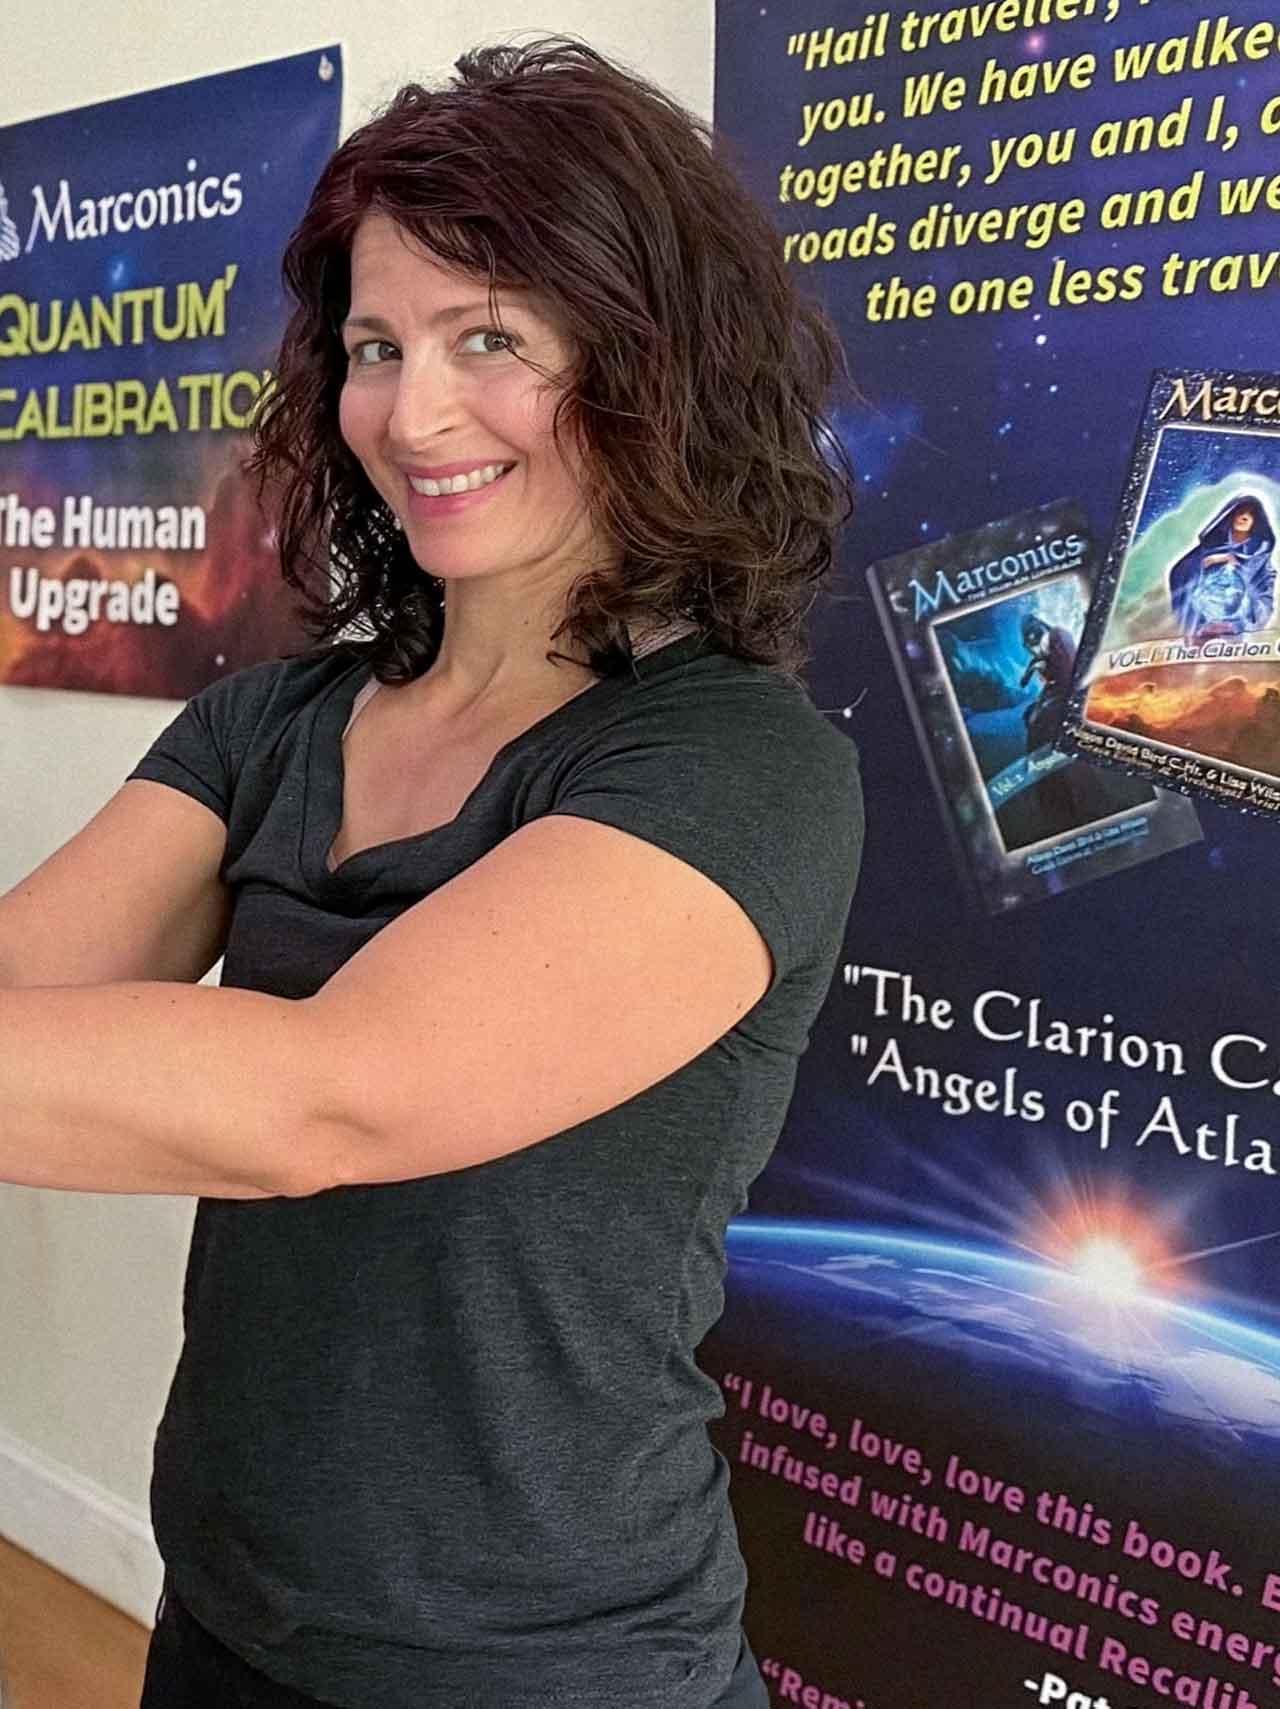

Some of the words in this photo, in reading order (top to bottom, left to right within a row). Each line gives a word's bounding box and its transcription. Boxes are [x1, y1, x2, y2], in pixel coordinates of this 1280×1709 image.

[787, 13, 890, 71] "Hail
[901, 0, 1120, 55] traveller,
[798, 92, 886, 146] you.
[903, 74, 965, 118] We
[979, 53, 1096, 105] have
[1114, 16, 1280, 83] walke
[779, 144, 973, 208] together,
[985, 128, 1076, 184] you
[1090, 97, 1193, 159] and
[25, 158, 243, 254] Marconics
[784, 213, 896, 264] roads
[909, 199, 1085, 249] diverge
[1101, 171, 1205, 229] and
[866, 277, 934, 321] the
[949, 273, 1033, 316] one
[1048, 260, 1145, 307] less
[1162, 252, 1280, 297] trav
[1158, 379, 1280, 420] Marc
[62, 496, 207, 549] Human
[10, 566, 180, 636] Upgrade
[908, 534, 1087, 624] Marconics
[844, 963, 955, 1031] "The
[972, 989, 1186, 1076] Clarion
[1211, 1033, 1280, 1097] C
[850, 1034, 1045, 1122] "Angels
[1065, 1090, 1120, 1150] of
[1135, 1096, 1278, 1175] Atla
[760, 1386, 837, 1449] love,
[848, 1419, 933, 1486] love,
[944, 1455, 1025, 1512] love
[1036, 1490, 1112, 1545] this
[1122, 1520, 1244, 1597] book.
[740, 1432, 862, 1507] infused
[869, 1493, 948, 1543] with
[958, 1520, 1160, 1626] Marconics
[1171, 1611, 1280, 1687] ener
[803, 1512, 865, 1564] like
[875, 1550, 898, 1577] a
[905, 1563, 1089, 1662] continual
